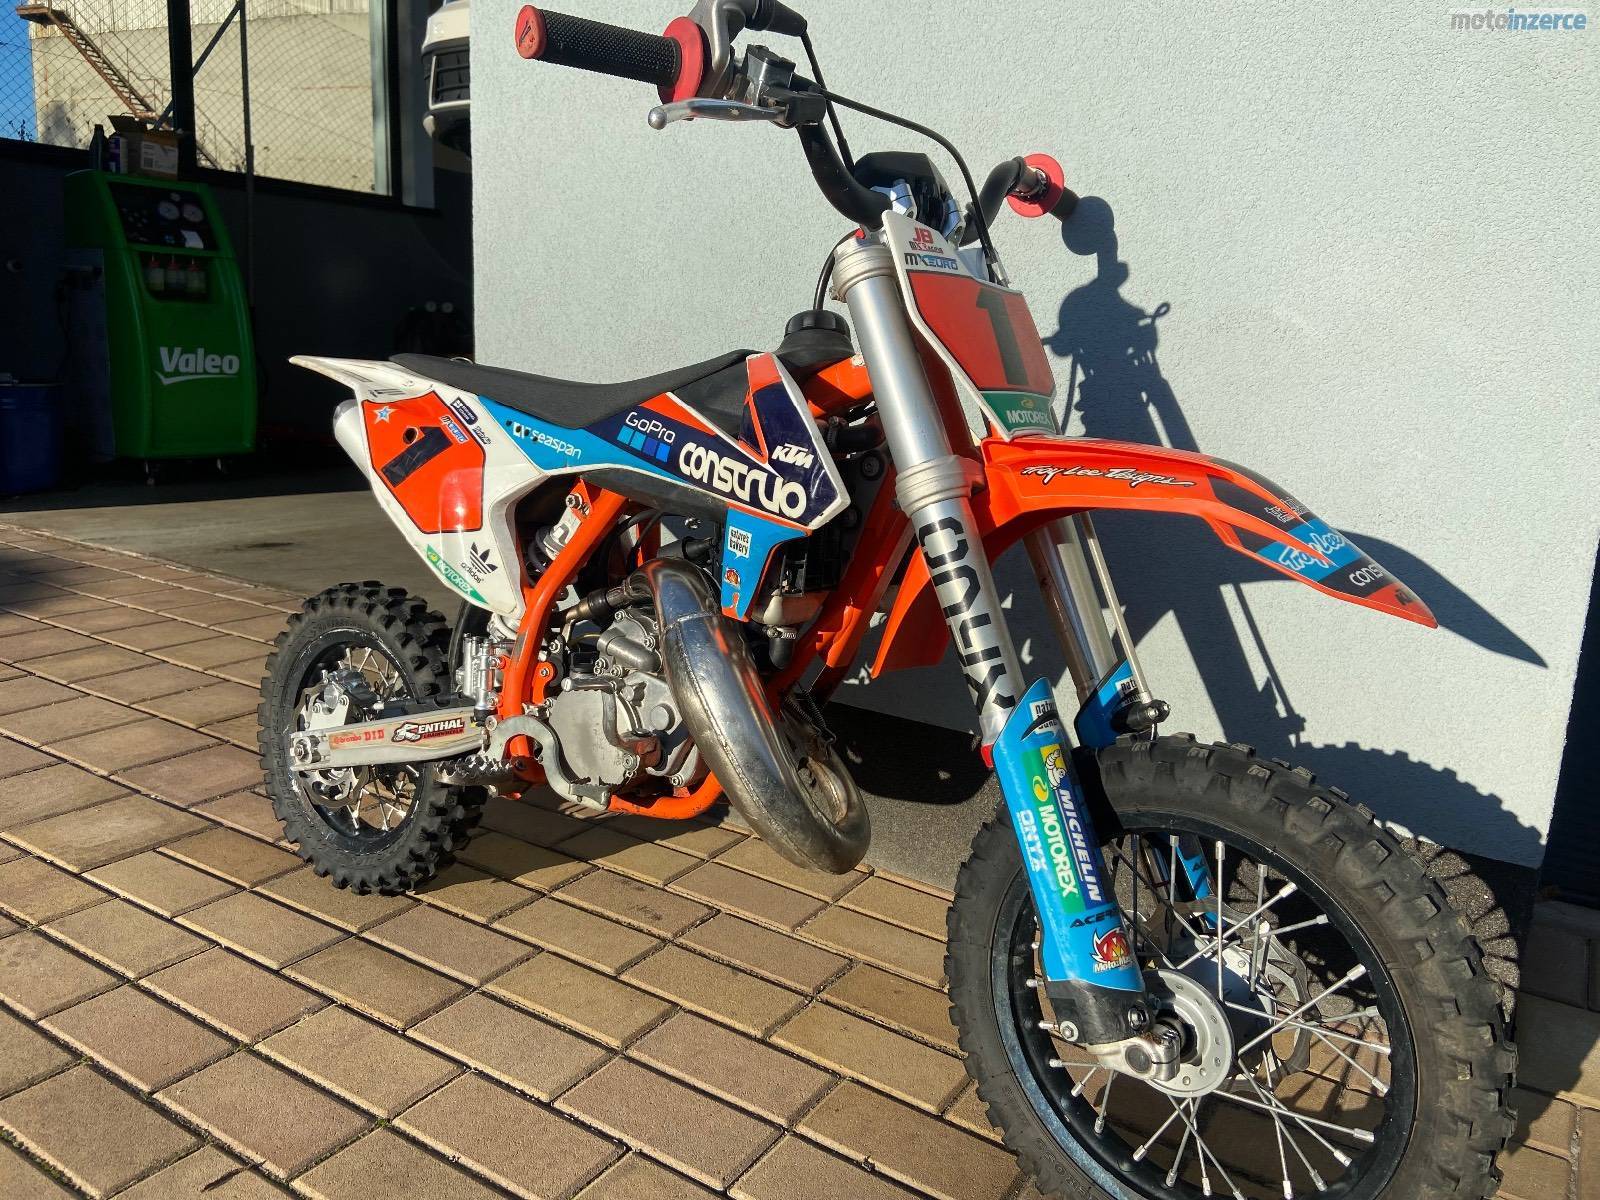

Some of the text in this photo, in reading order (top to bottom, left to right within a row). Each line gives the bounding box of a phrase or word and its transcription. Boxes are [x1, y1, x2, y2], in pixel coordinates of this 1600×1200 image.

[976, 288, 1029, 385] 1
[159, 346, 240, 375] Valeo
[625, 411, 676, 443] GoPro
[381, 426, 454, 488] 1
[530, 429, 582, 460] seaspan
[771, 442, 815, 469] KTM
[1021, 465, 1198, 488] Troy Lee Designs
[436, 560, 475, 595] MOTOREX
[460, 562, 484, 584] adidas
[363, 729, 385, 742] DID
[1038, 804, 1078, 897] MOTOREX
[1059, 788, 1102, 902] MICHELIN
